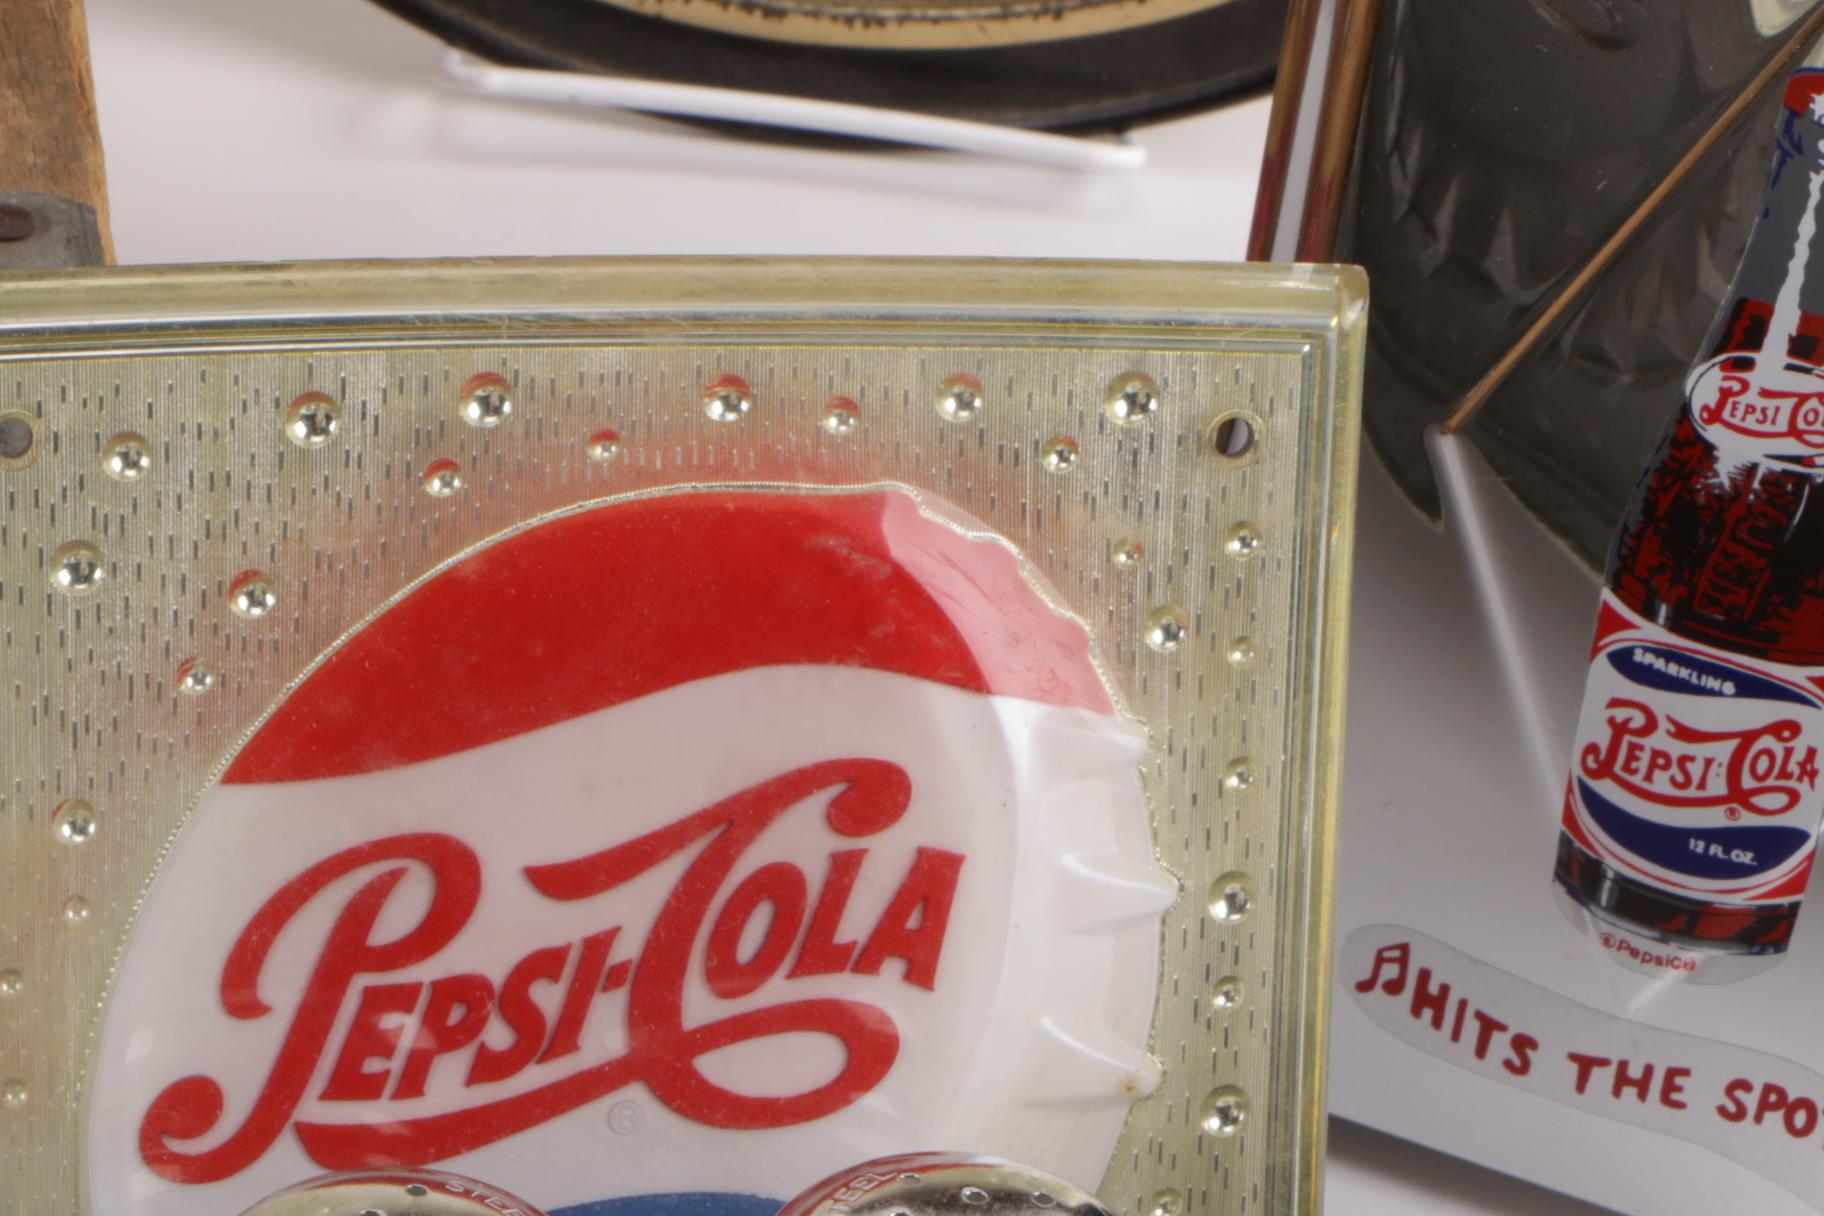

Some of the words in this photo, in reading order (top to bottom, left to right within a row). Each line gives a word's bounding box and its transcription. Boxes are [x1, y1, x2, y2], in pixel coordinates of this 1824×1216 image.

[1632, 648, 1737, 696] SPARKLING
[1688, 837, 1706, 855] 12
[1410, 966, 1540, 1077] HITS
[1567, 1052, 1693, 1111] THE
[1715, 1077, 1824, 1153] SPO
